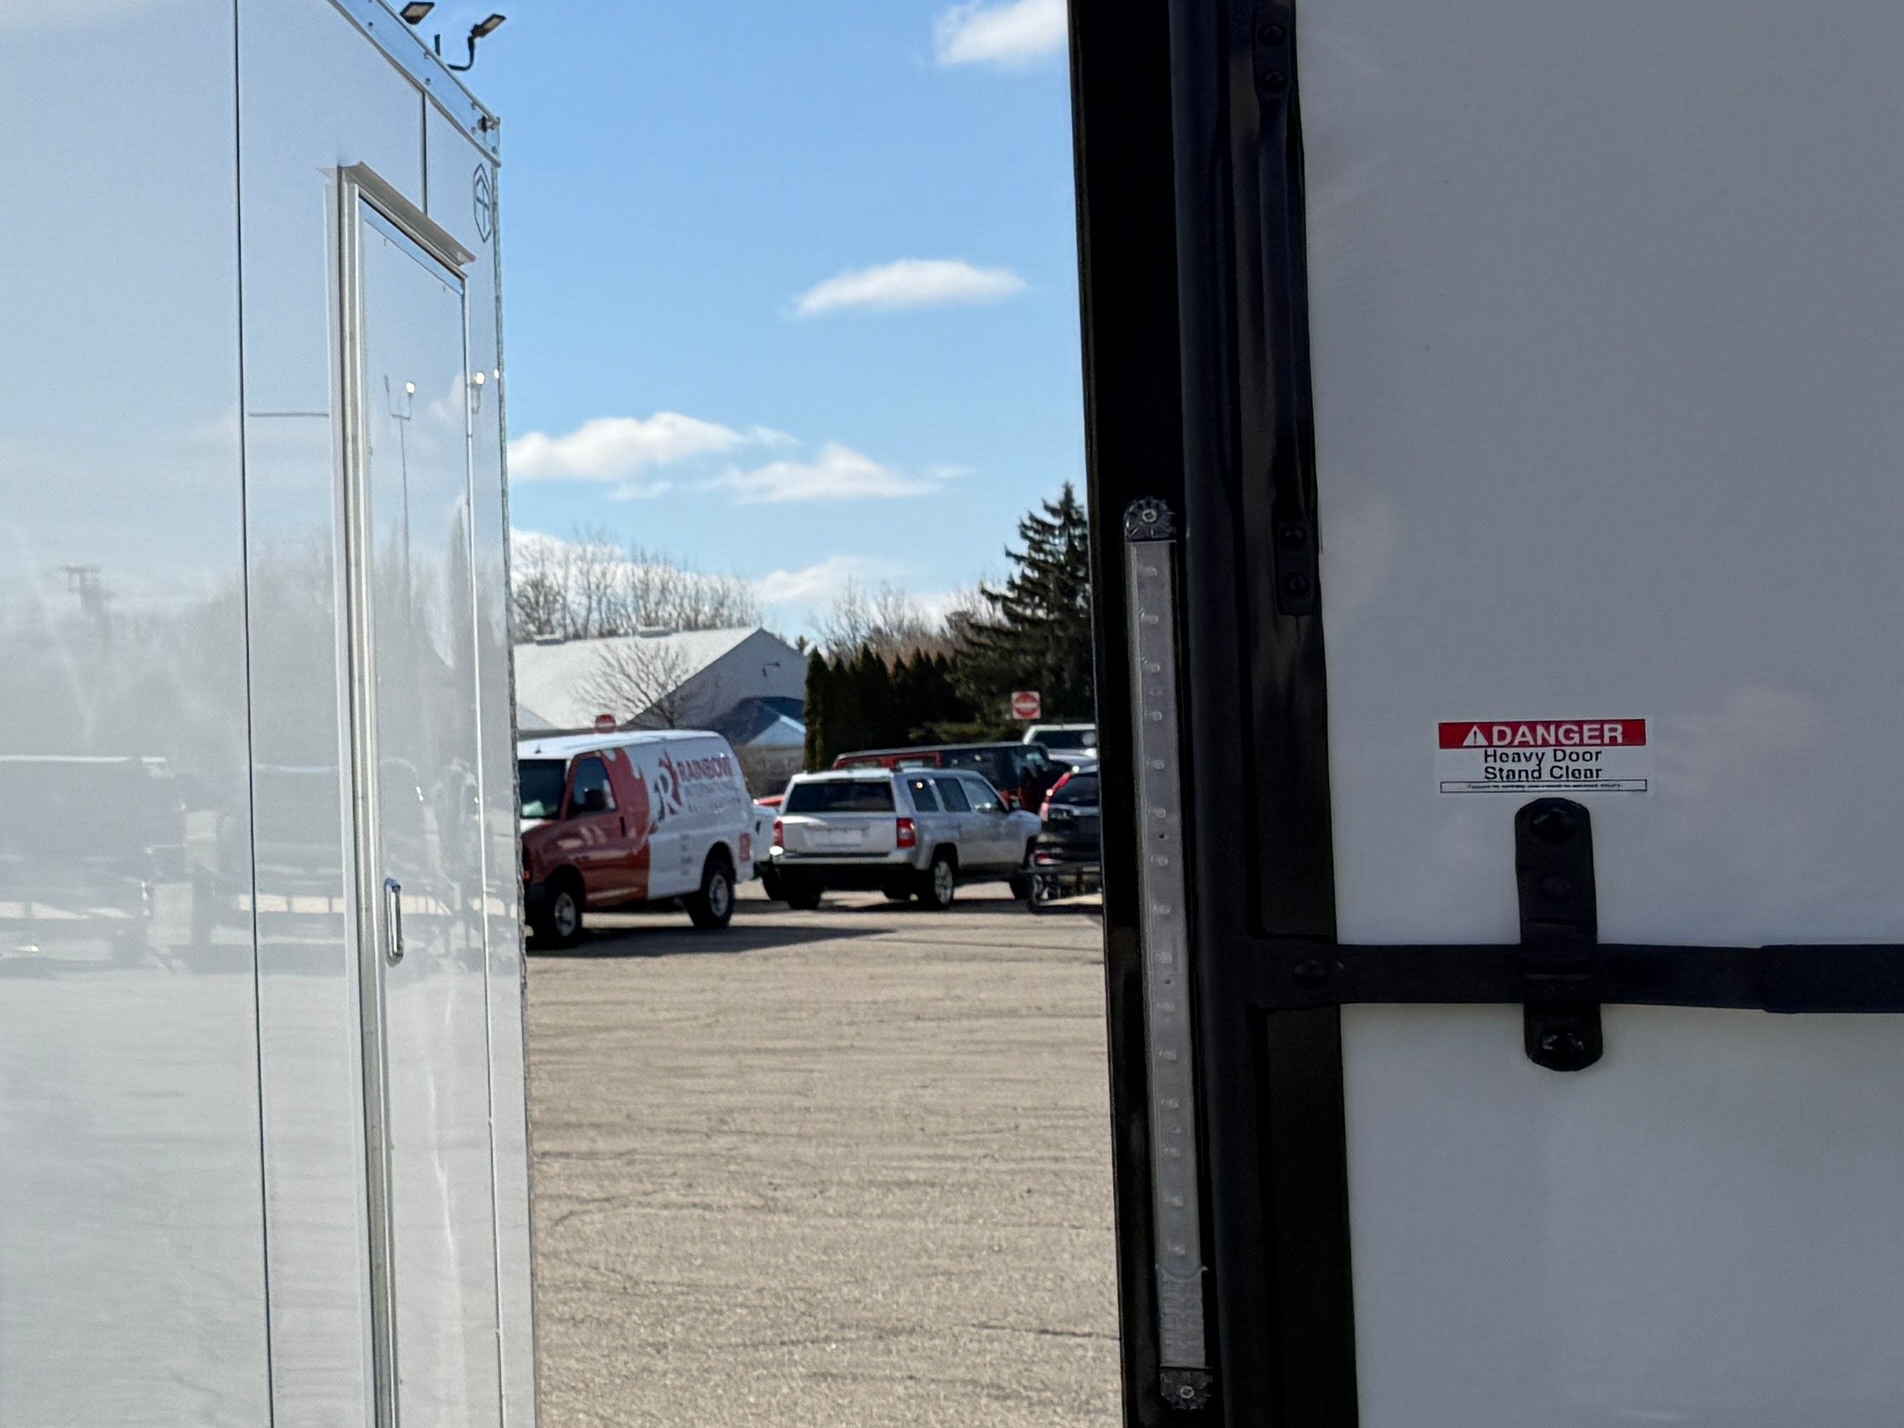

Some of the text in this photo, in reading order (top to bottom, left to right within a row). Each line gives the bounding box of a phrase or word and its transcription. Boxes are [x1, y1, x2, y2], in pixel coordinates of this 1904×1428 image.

[1492, 723, 1623, 747] DANGER
[1484, 748, 1603, 766] Heavy Door
[1484, 764, 1603, 781] Stand Clear
